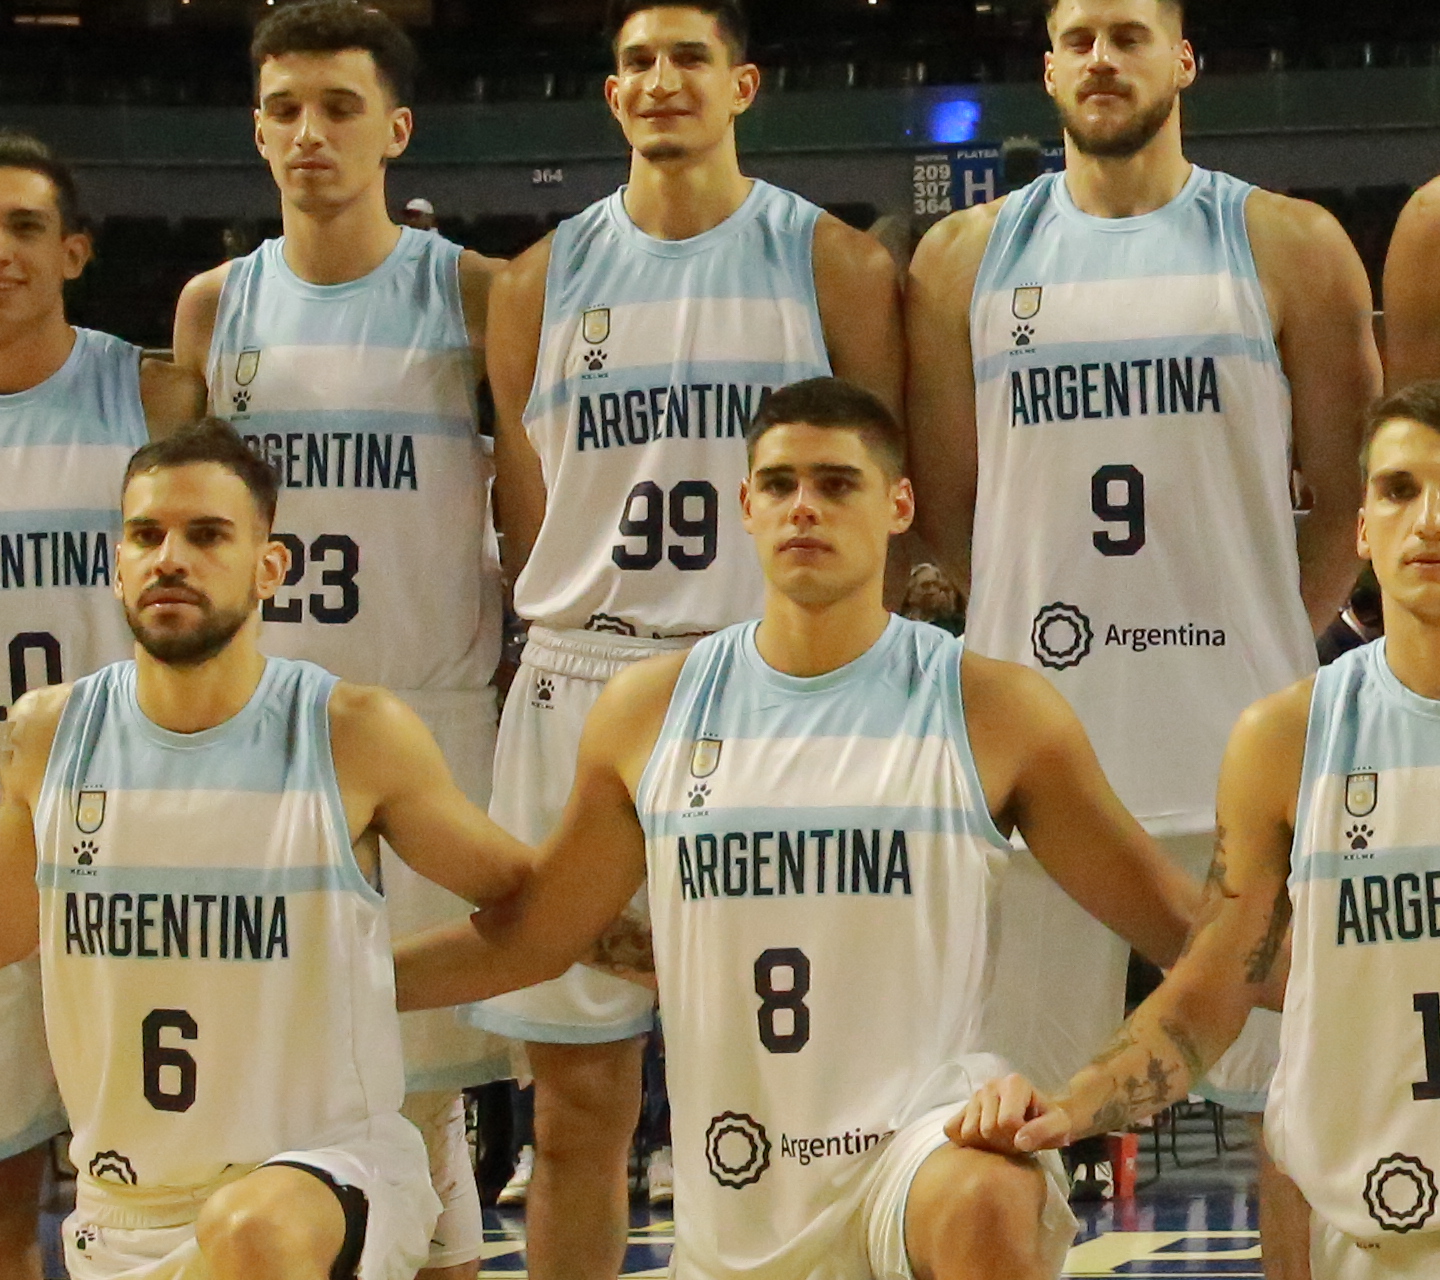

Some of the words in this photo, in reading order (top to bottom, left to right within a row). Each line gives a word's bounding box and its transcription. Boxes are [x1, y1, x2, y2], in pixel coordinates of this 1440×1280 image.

[914, 163, 951, 181] 209
[957, 149, 1000, 160] PLATEA
[963, 168, 995, 208] H
[915, 180, 951, 198] 307
[915, 196, 953, 216] 364
[1012, 358, 1221, 427] ARGENTINA
[612, 480, 718, 571] 99
[1092, 464, 1145, 557] 9
[262, 533, 359, 624] 23
[1105, 624, 1226, 653] Argentina
[678, 829, 912, 902] ARGENTINA
[1343, 853, 1375, 861] KELME
[65, 892, 288, 960] ARGENTINA
[754, 947, 811, 1054] 8
[141, 1009, 198, 1113] 6
